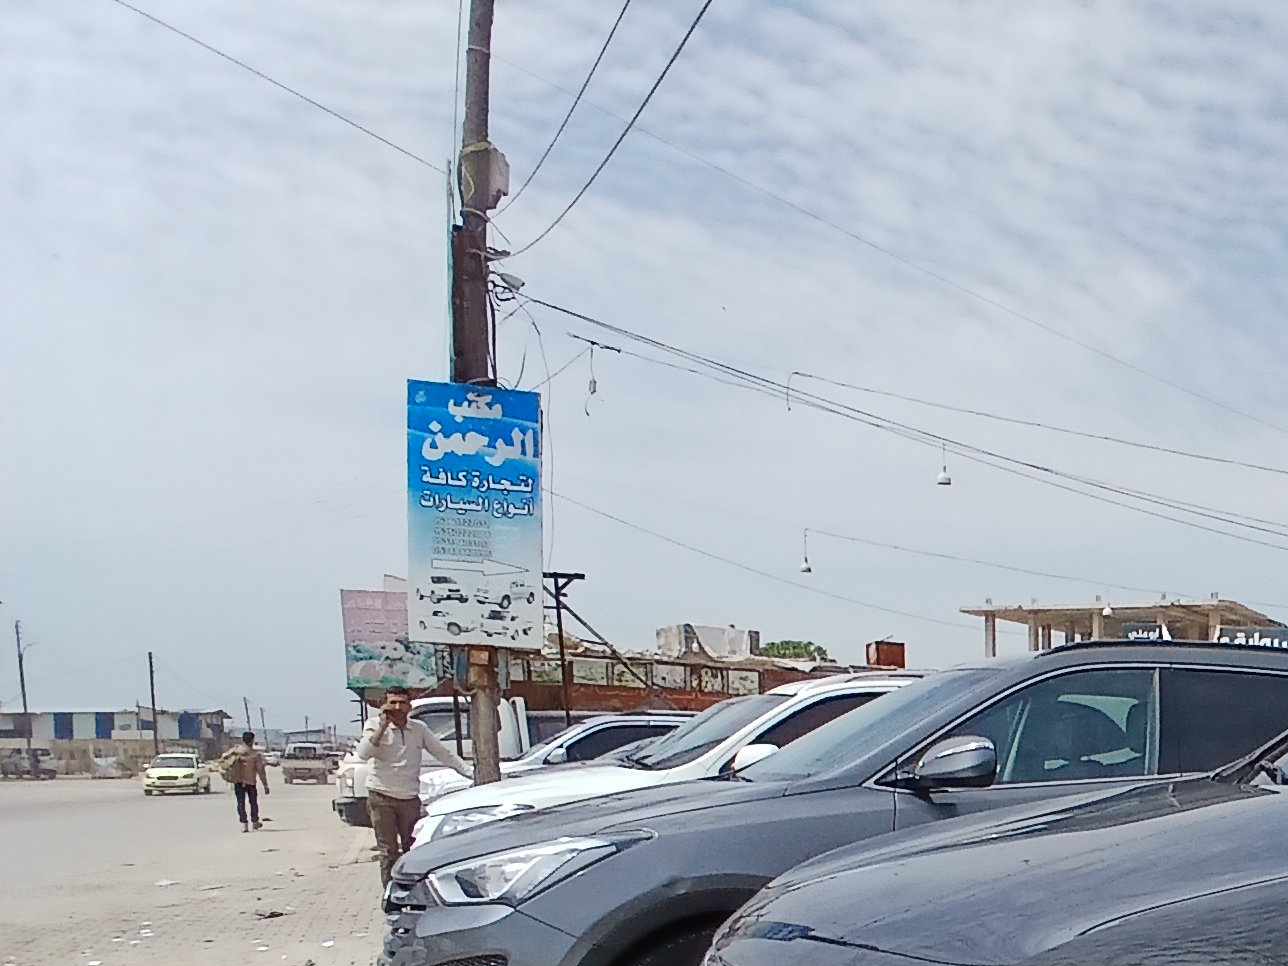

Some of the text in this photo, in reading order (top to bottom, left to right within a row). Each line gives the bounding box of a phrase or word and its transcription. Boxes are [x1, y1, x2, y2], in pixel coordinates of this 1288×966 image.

[448, 392, 502, 422] مكتب
[421, 421, 534, 466] الرحمن
[420, 465, 535, 495] لتجارة كافة
[420, 490, 489, 514] السيارات
